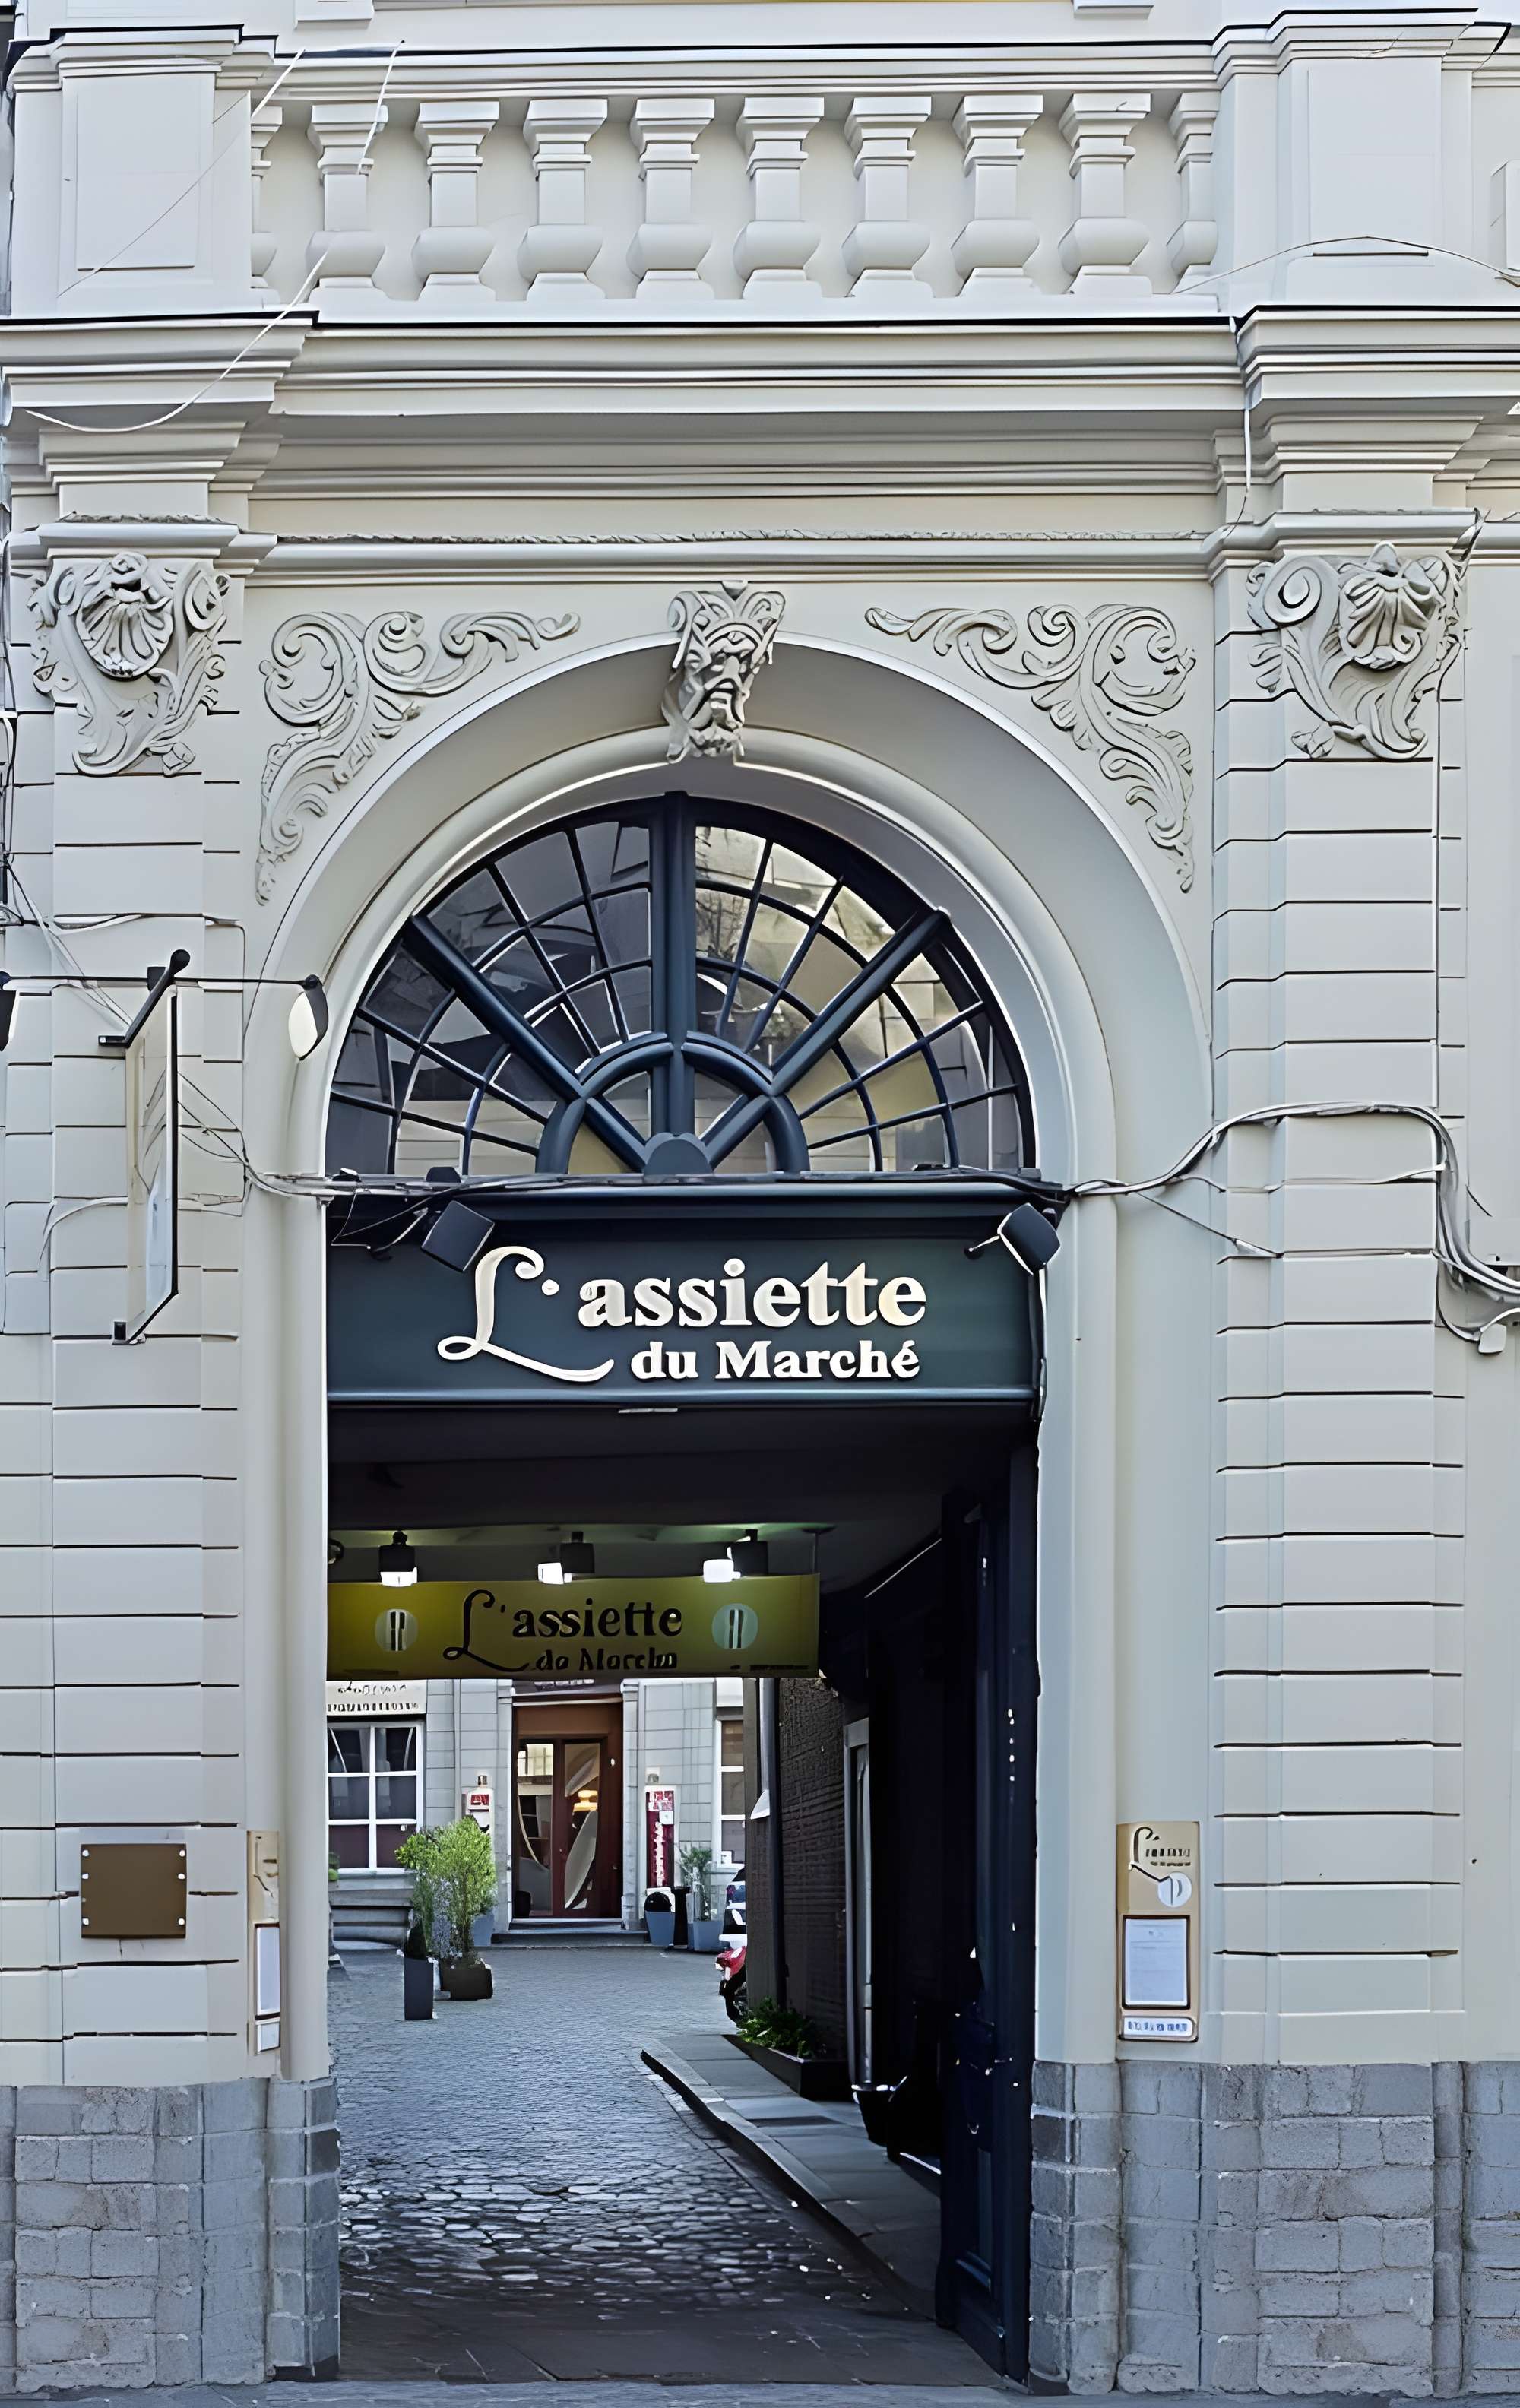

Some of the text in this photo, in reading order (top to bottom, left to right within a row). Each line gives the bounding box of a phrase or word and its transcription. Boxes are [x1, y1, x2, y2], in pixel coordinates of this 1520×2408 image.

[437, 1245, 928, 1383] L'assiette
[630, 1340, 921, 1380] du Marché
[443, 1589, 682, 1672] L'assiette
